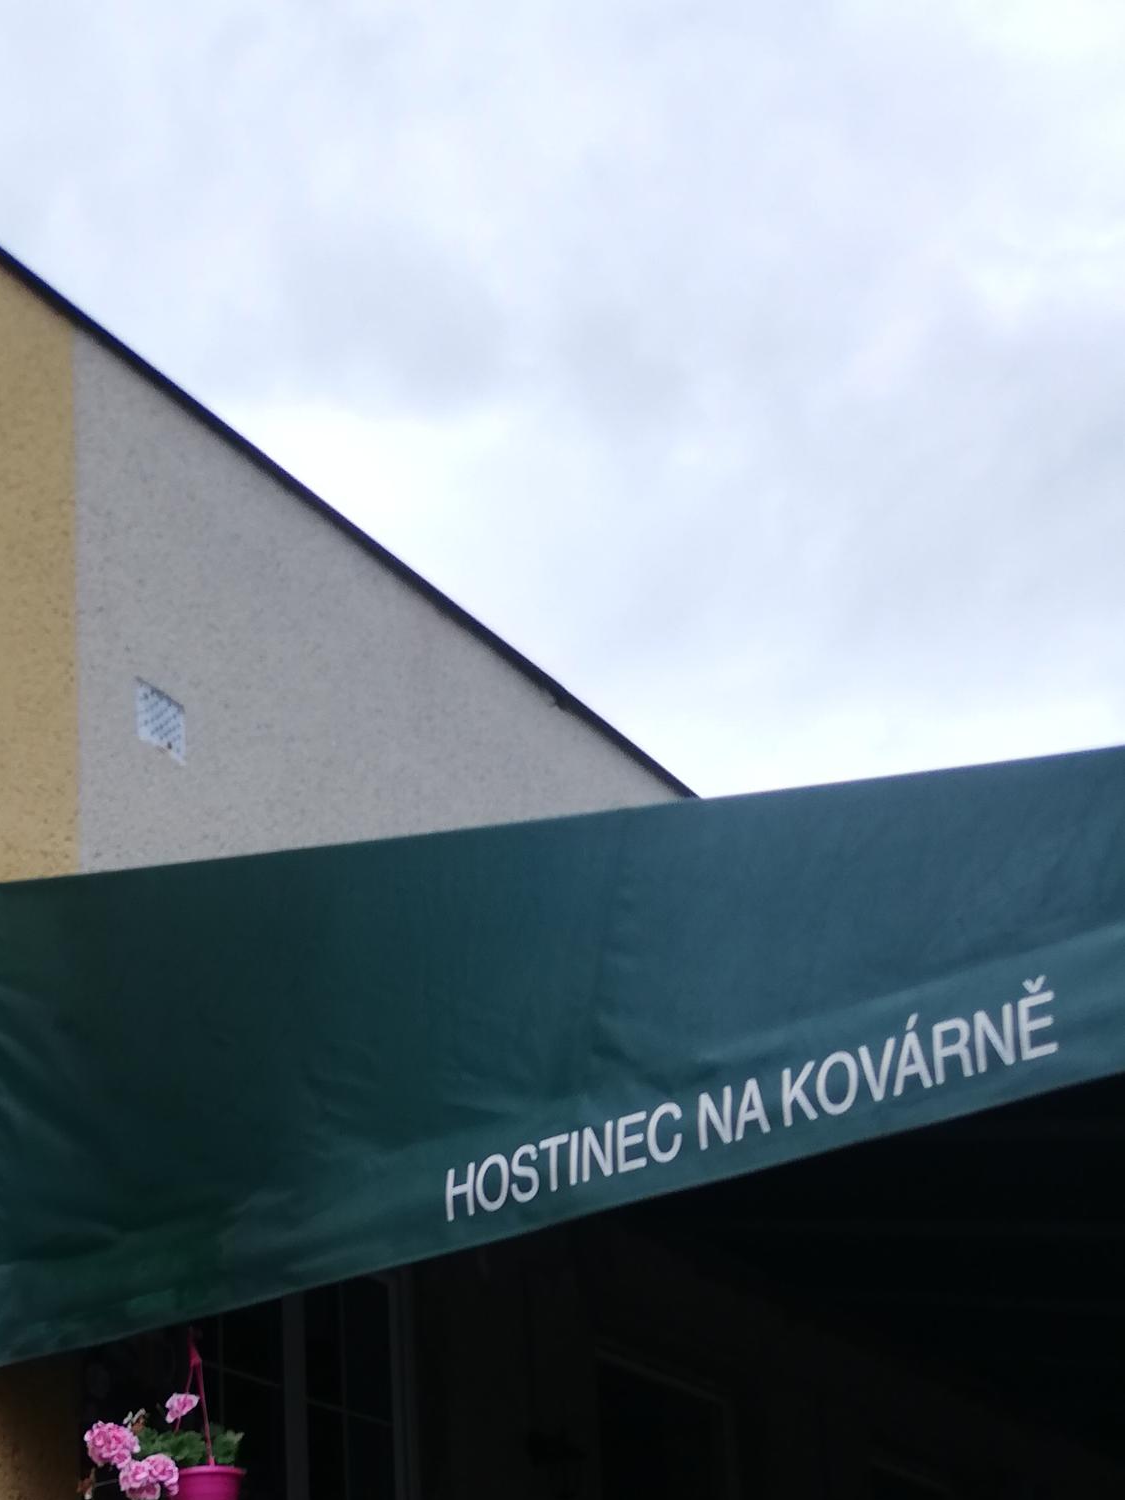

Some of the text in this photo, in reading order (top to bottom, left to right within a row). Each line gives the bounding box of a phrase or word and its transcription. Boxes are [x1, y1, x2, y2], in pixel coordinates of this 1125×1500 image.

[445, 974, 1060, 1222] HOSTINEC NA KOVÁRNĚ
